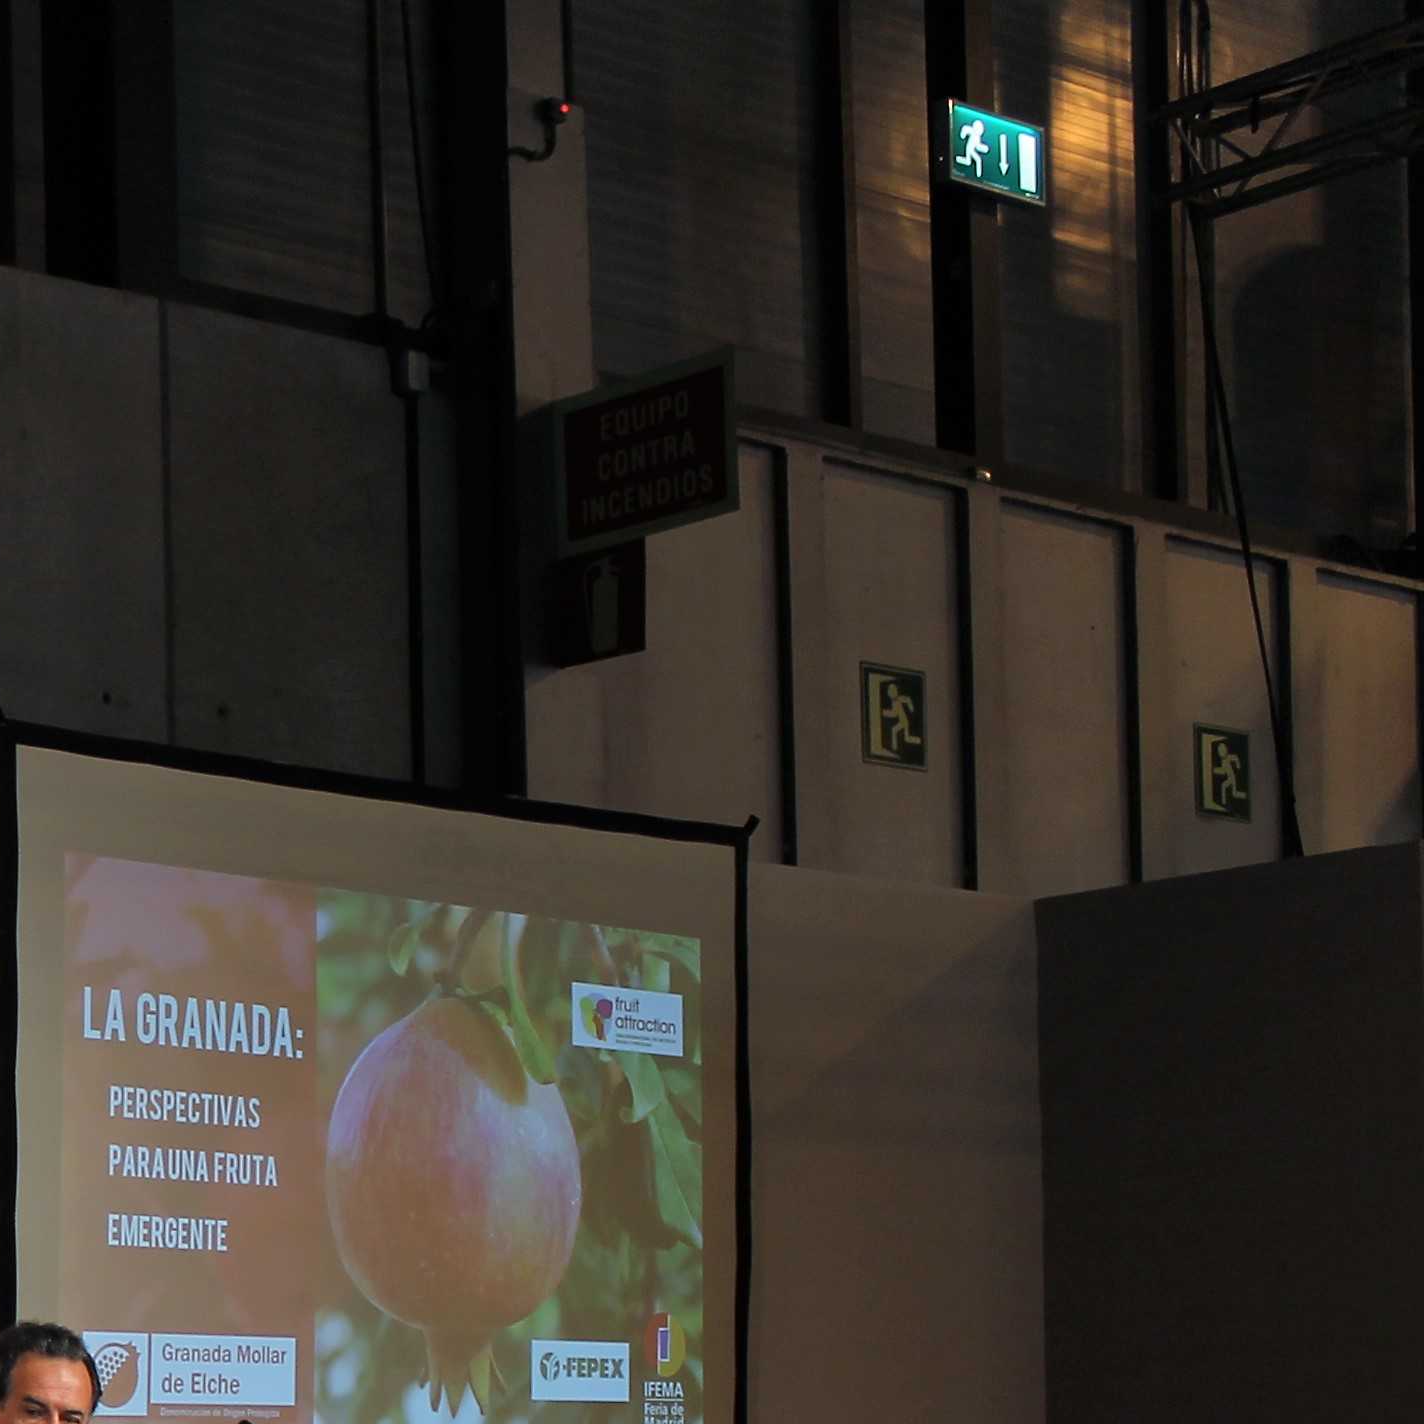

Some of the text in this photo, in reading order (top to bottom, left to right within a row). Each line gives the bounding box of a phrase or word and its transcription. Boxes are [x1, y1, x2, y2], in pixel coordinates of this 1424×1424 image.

[600, 391, 689, 440] EQUIPO
[597, 431, 696, 481] CONTRA
[580, 464, 713, 526] INCENDIOS
[83, 986, 304, 1059] LA GRANADA:
[615, 996, 640, 1013] fruit
[615, 1016, 676, 1035] attraction
[109, 1085, 261, 1128] PERSPECTIVAS
[214, 1151, 278, 1187] FRUTA
[108, 1213, 228, 1251] EMERGENTE
[162, 1343, 287, 1365] Granada Mollar
[162, 1372, 240, 1394] de Elche
[644, 1381, 684, 1398] IFEMA
[644, 1402, 684, 1416] Feria de
